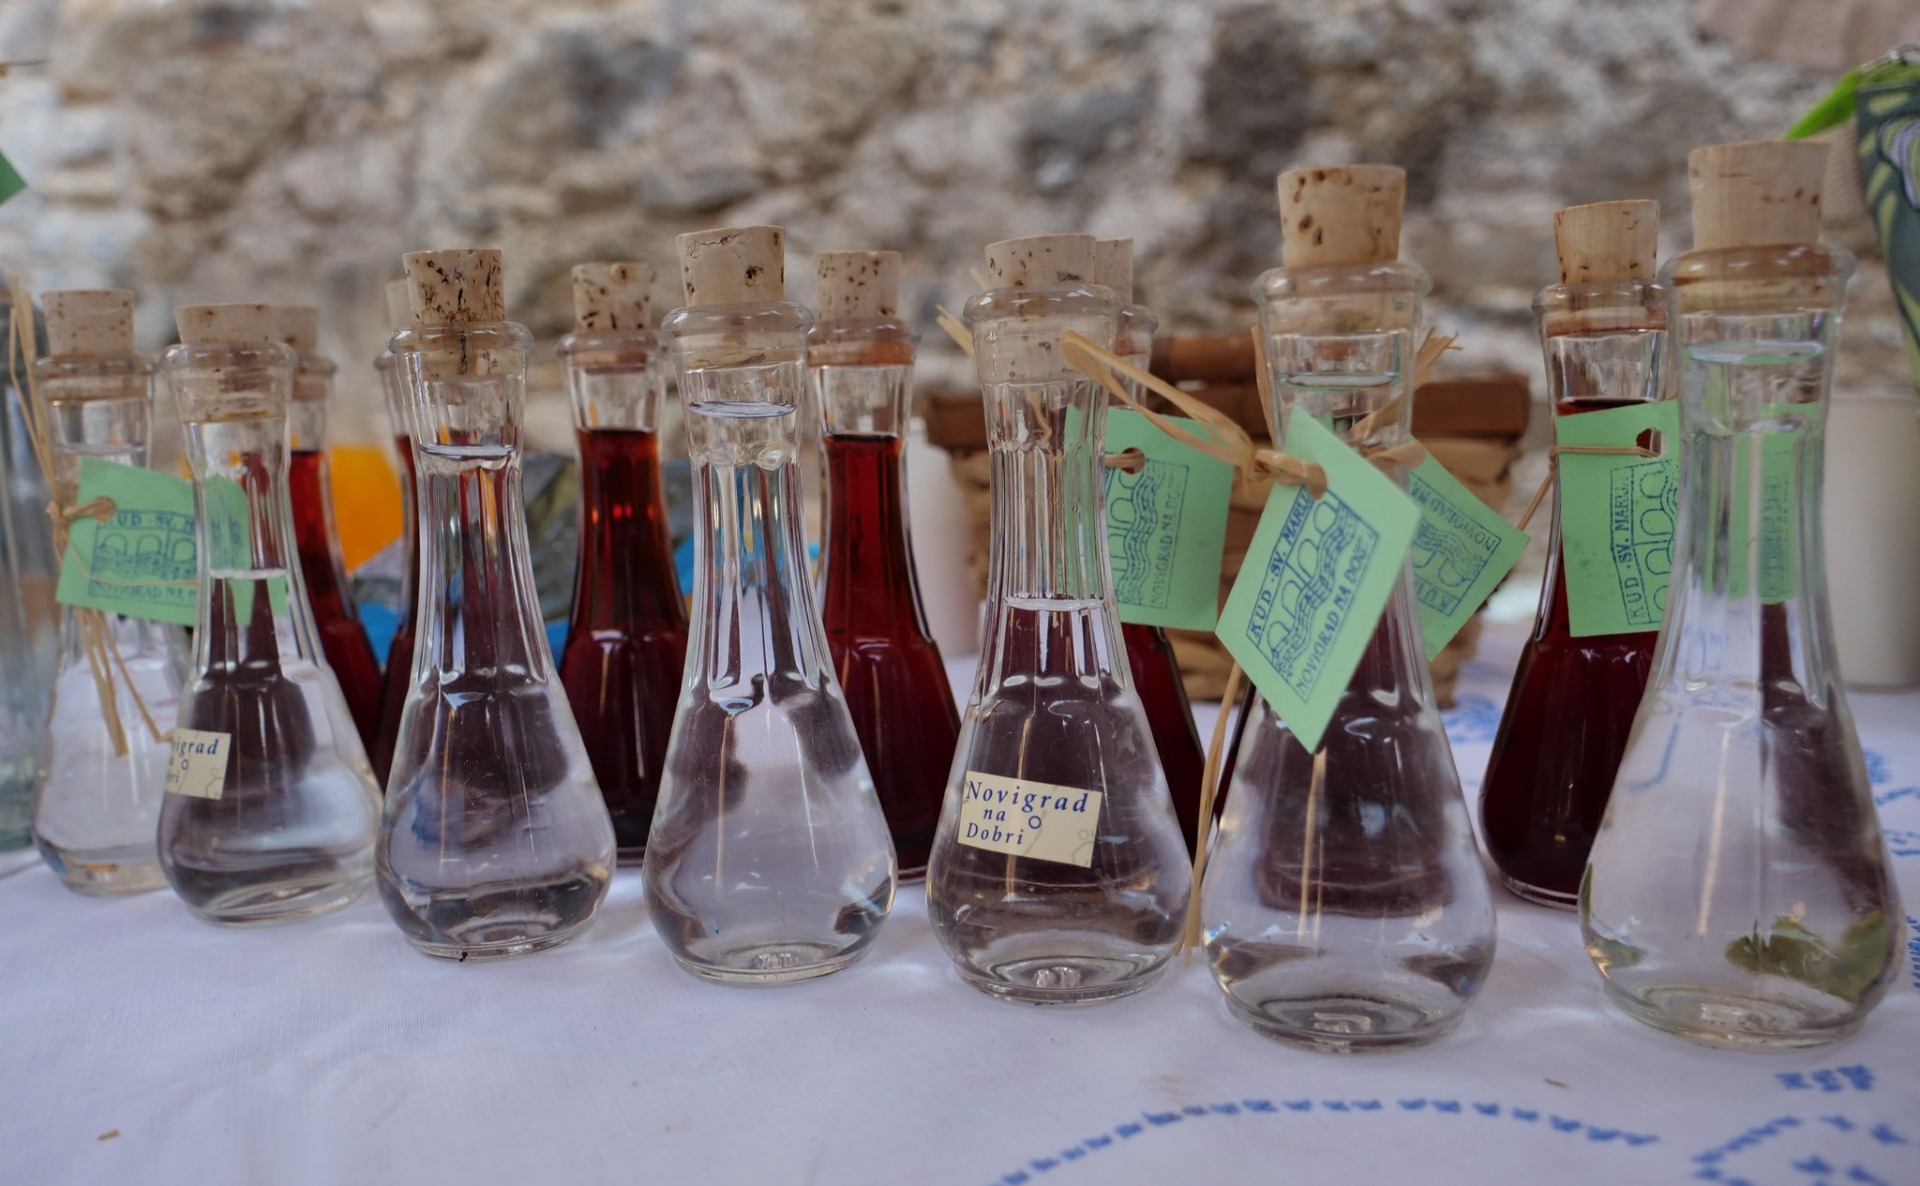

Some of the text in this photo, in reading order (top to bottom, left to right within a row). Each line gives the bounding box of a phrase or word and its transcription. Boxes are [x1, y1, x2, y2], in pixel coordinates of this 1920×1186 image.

[1251, 589, 1273, 638] KUD
[966, 781, 1088, 813] Novigrad
[983, 807, 1006, 822] na
[966, 822, 1024, 845] Dobri
